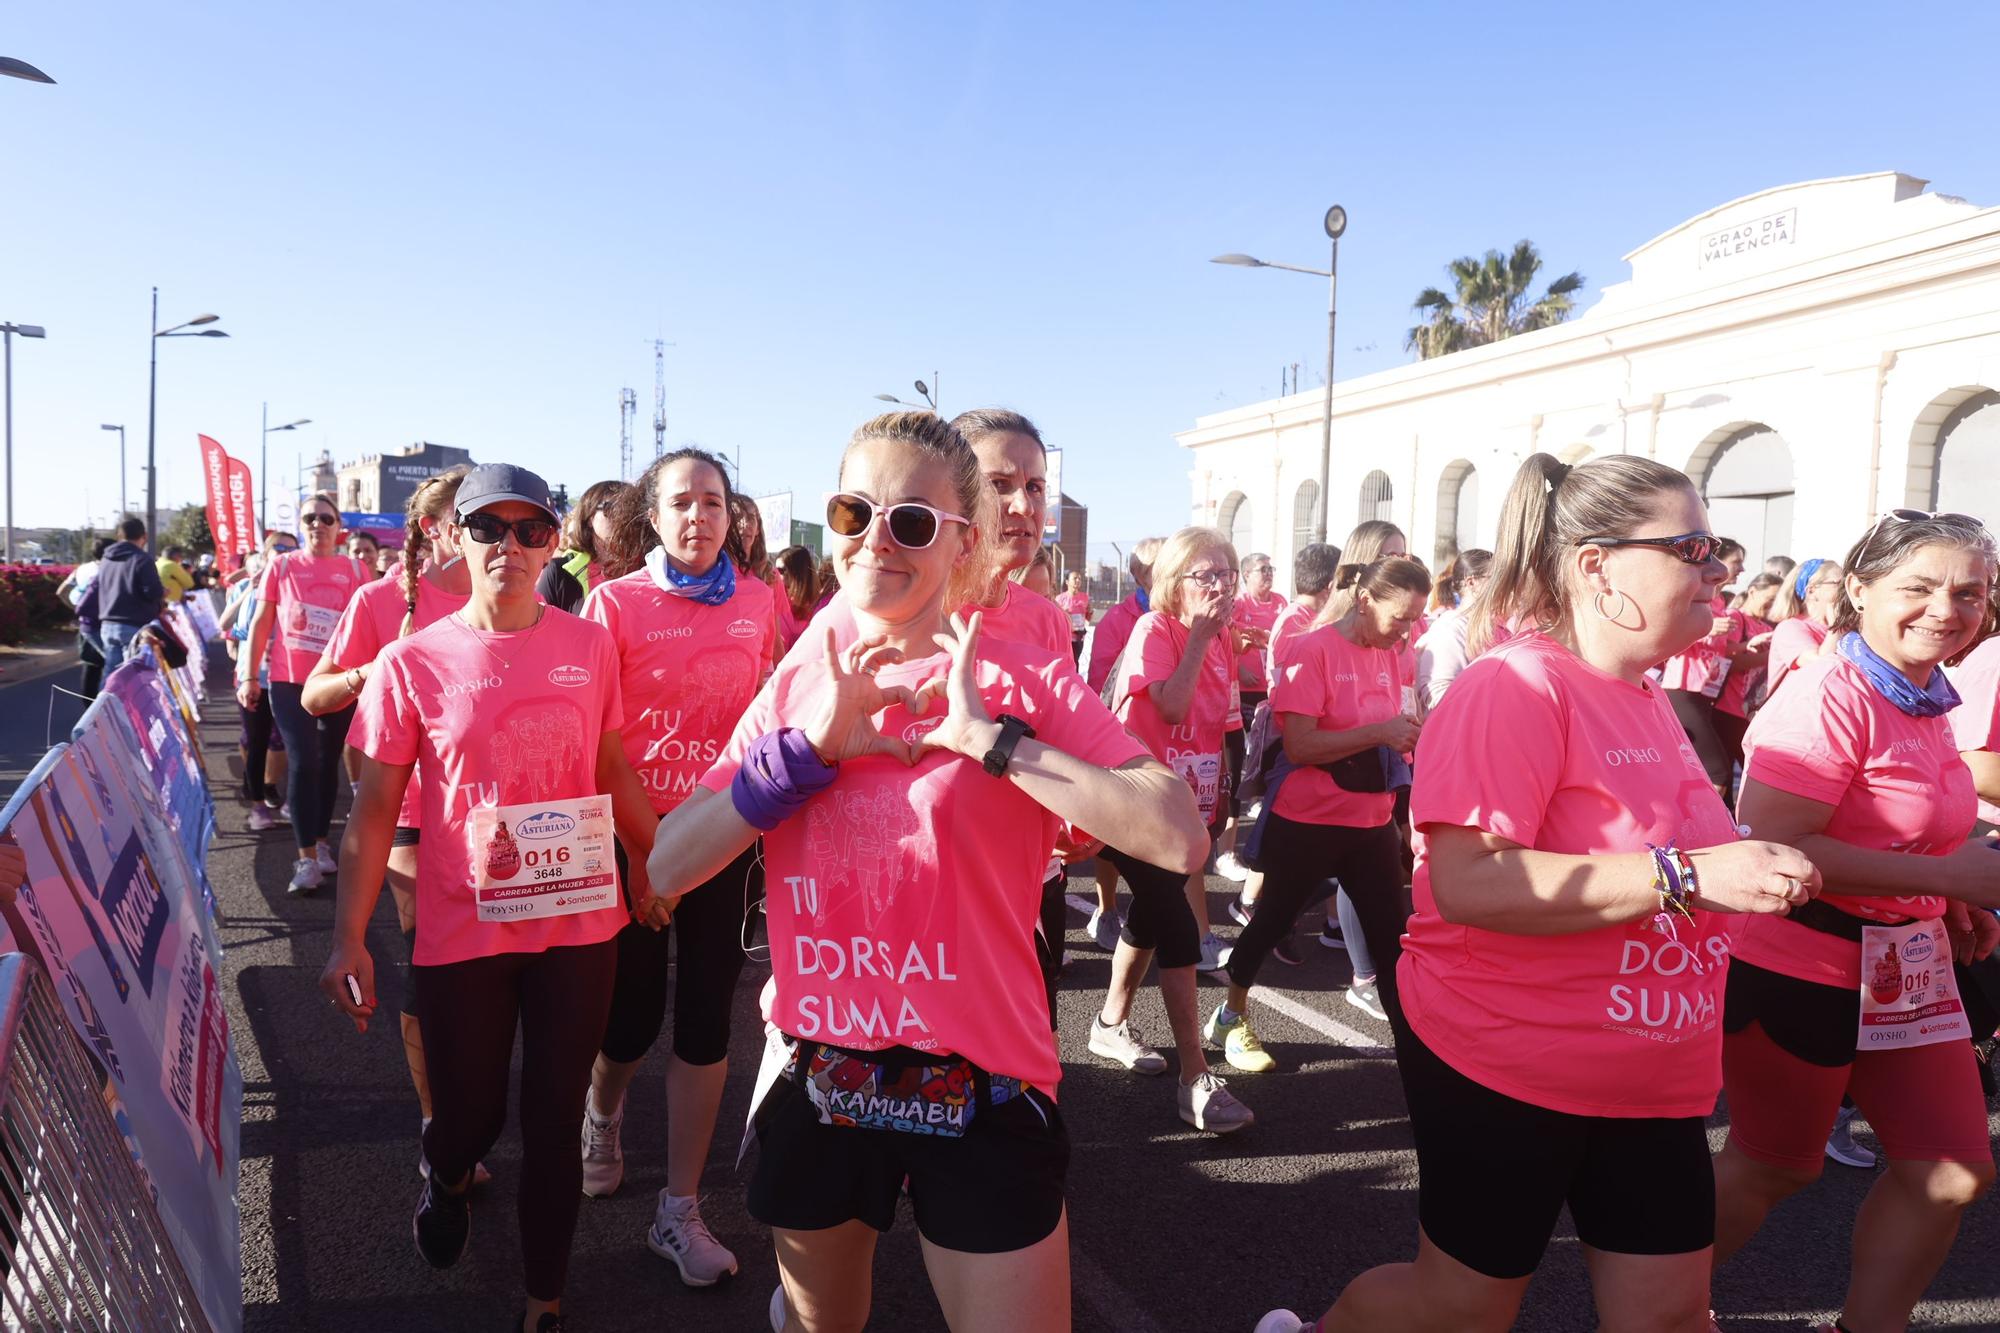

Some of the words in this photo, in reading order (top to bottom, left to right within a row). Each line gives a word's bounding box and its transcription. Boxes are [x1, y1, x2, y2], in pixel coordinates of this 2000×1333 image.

[1763, 215, 1786, 232] DE
[1704, 229, 1788, 262] VALENCIA
[646, 626, 693, 642] OYSHO
[444, 675, 503, 697] OYSHO
[552, 672, 588, 683] ASTURIANA
[650, 709, 682, 731] TU
[1171, 724, 1196, 742] TU
[1605, 747, 1661, 767] OYSHO
[637, 768, 697, 793] SUM
[458, 780, 500, 810] TU
[579, 811, 604, 820] SUMA
[521, 822, 571, 835] ASTURIANA
[524, 846, 571, 867] 016
[533, 867, 563, 880] 3648
[494, 887, 532, 898] CARRERA
[534, 885, 544, 893] DE
[546, 883, 557, 891] LA
[558, 879, 584, 890] MUJER
[586, 876, 604, 886] 2023
[783, 875, 818, 917] TU
[491, 903, 534, 914] OYSHO
[567, 892, 608, 905] Santander
[795, 935, 957, 984] DORSAL
[1905, 943, 1932, 957] ASTURIANA
[1904, 970, 1930, 991] 016
[1909, 992, 1925, 1005] 4087
[796, 994, 932, 1038] SUMA
[1875, 1014, 1908, 1022] CARRERA
[1601, 1023, 1649, 1039] CARRERA
[1650, 1031, 1667, 1042] DE
[1666, 1035, 1681, 1043] LA
[1870, 1030, 1907, 1042] OYSHO
[1927, 1021, 1960, 1033] Santander
[912, 1038, 938, 1050] 2023
[830, 1087, 964, 1128] KAMUABU
